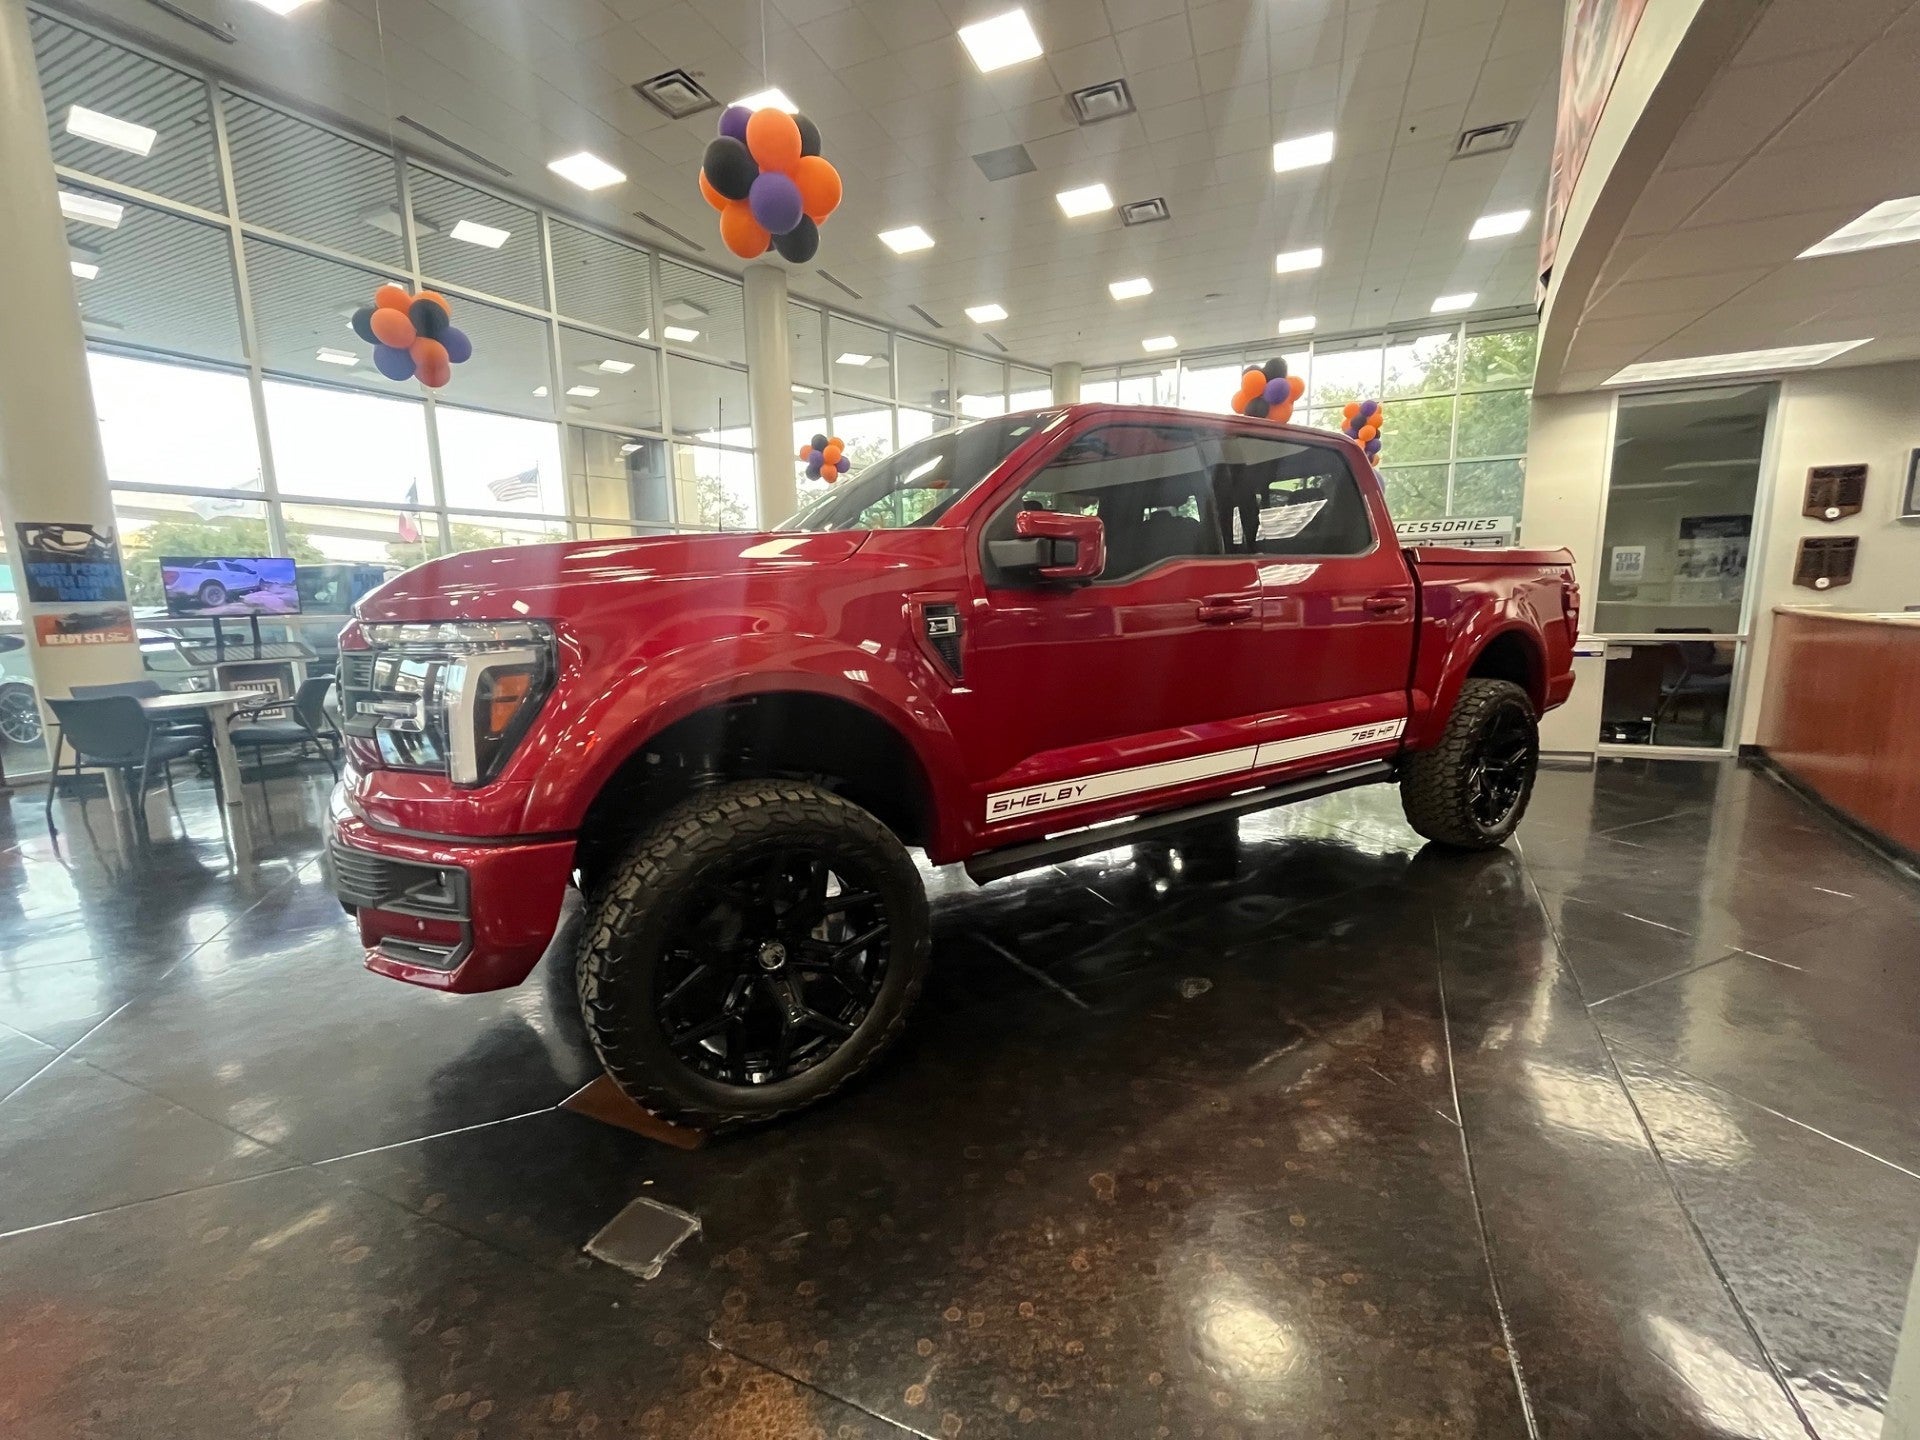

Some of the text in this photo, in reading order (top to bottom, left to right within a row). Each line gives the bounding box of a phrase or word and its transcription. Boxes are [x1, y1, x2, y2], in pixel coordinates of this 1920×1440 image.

[1396, 519, 1499, 533] CESSORIES
[45, 634, 82, 645] READY
[83, 633, 105, 644] SET
[1377, 725, 1395, 737] HP
[992, 784, 1087, 813] SHELBY
